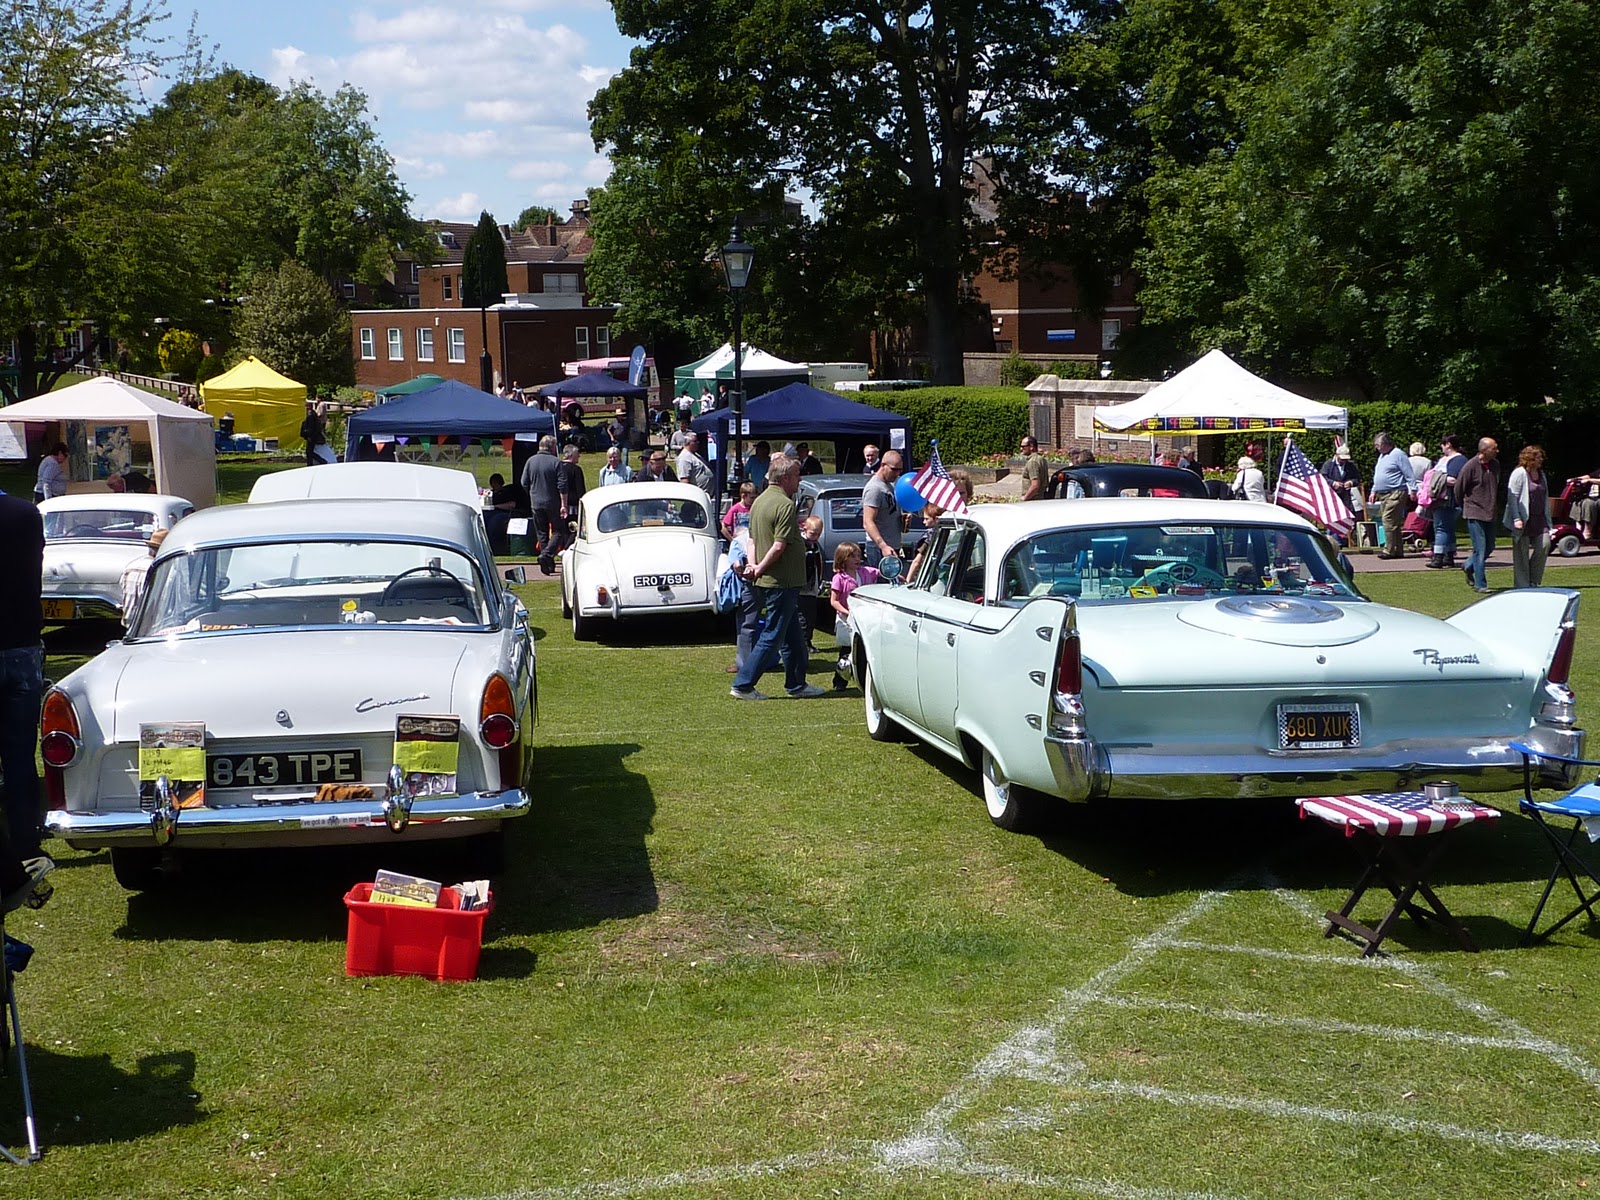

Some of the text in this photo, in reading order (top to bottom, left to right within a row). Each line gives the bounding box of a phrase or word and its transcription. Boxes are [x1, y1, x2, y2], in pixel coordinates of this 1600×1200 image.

[635, 574, 690, 586] ERO 769G
[45, 608, 61, 617] PAT
[1413, 648, 1480, 673] Plymouth
[1284, 704, 1354, 712] PLYMOUTH
[1287, 716, 1351, 737] 680 XUK
[212, 753, 355, 785] 843 TPE
[311, 818, 320, 827] got
